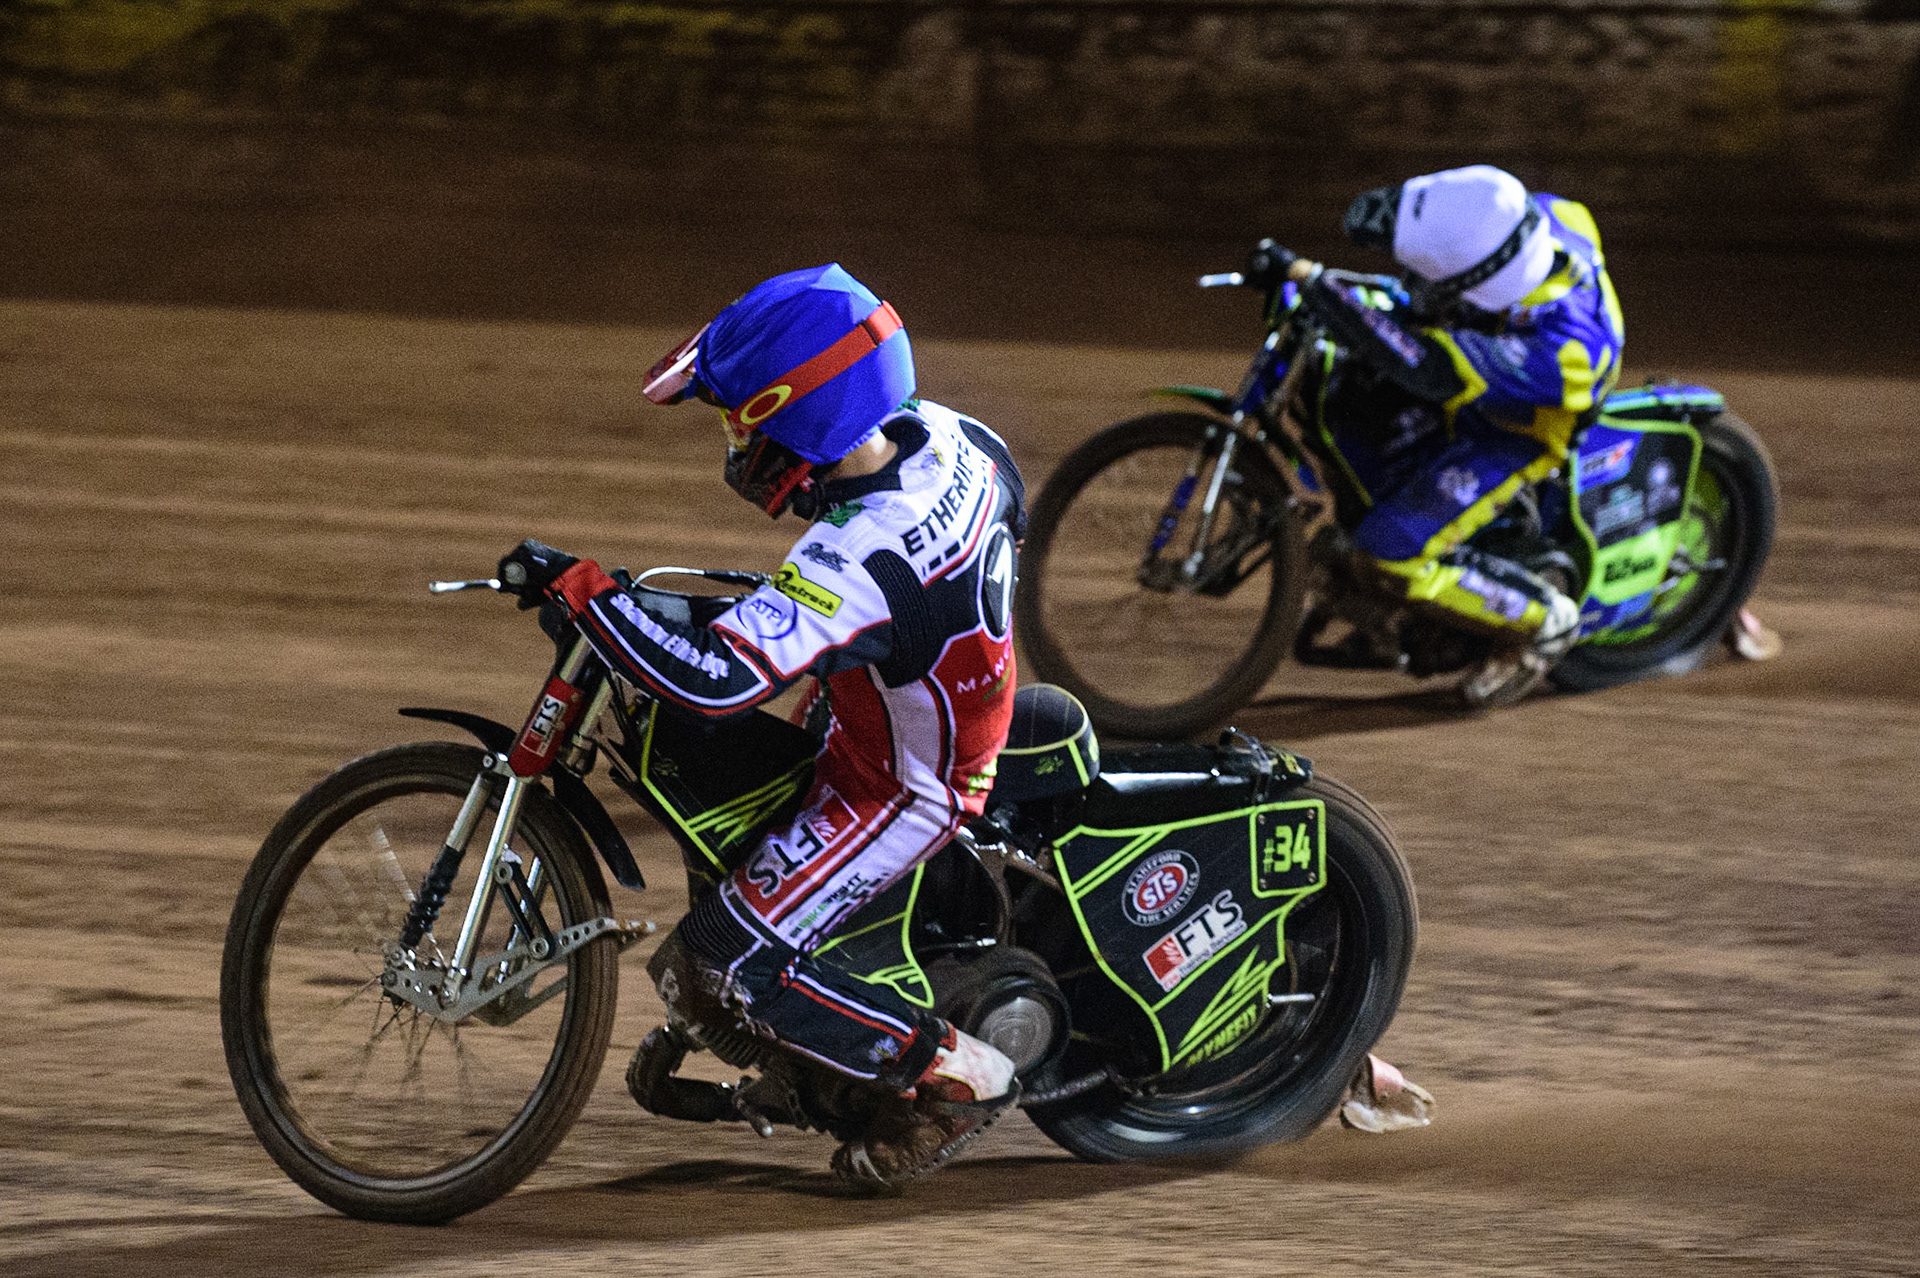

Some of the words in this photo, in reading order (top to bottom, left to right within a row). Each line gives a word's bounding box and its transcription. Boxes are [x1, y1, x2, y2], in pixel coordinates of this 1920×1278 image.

[531, 697, 560, 735] FTS
[749, 821, 825, 895] FTS
[1263, 823, 1311, 873] #34
[1142, 870, 1178, 908] STS
[1175, 893, 1239, 957] FTS
